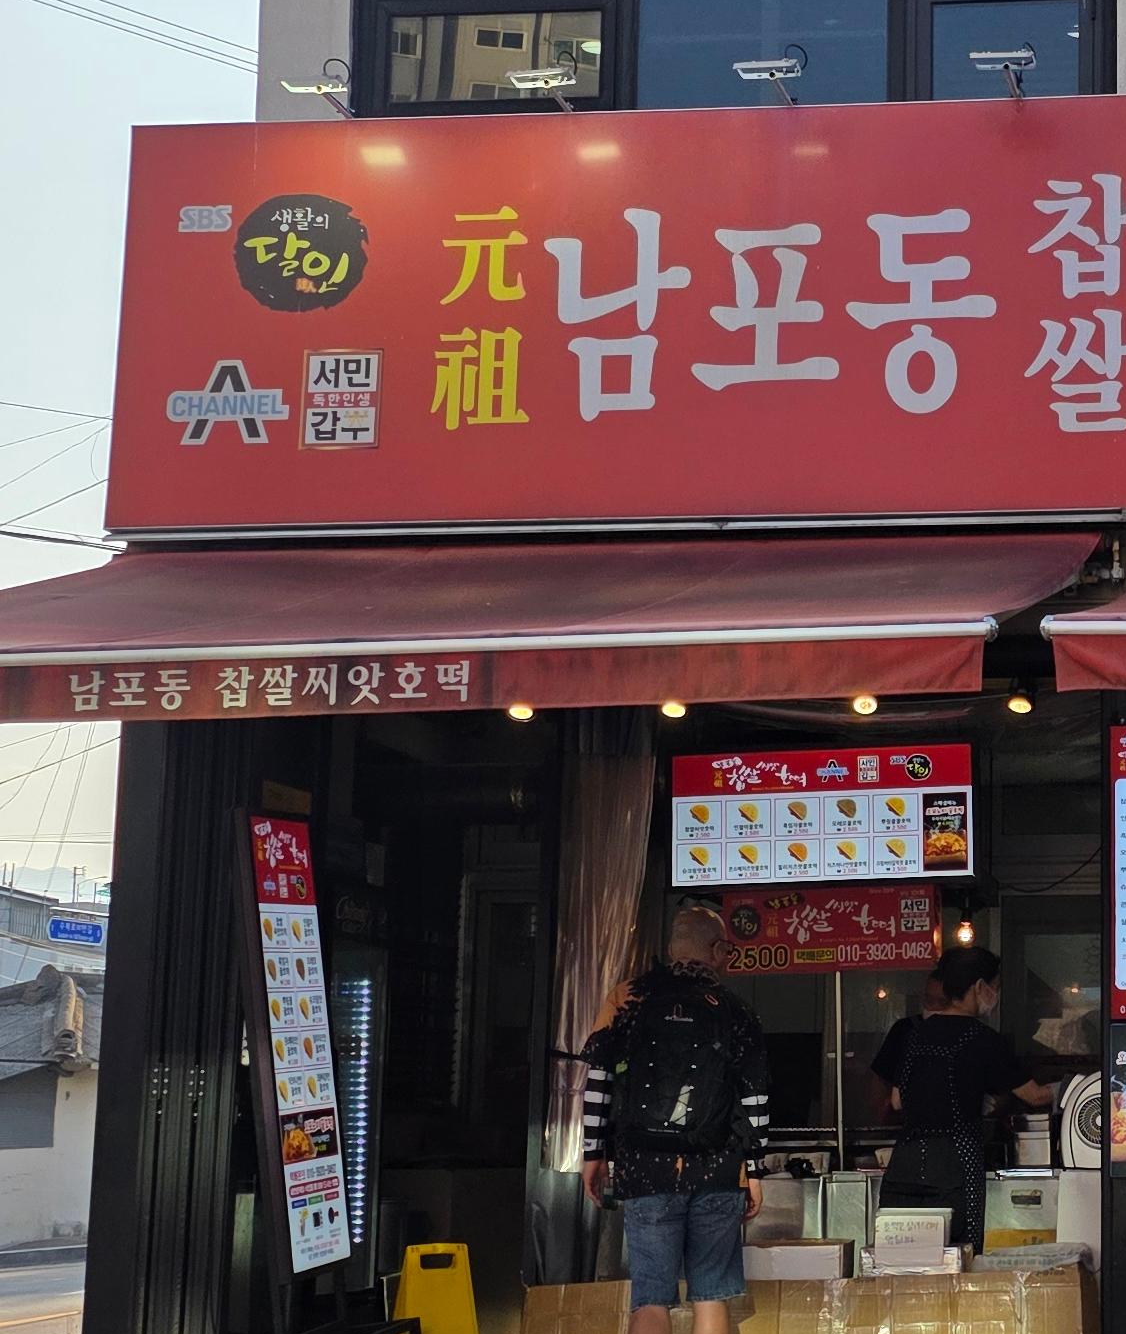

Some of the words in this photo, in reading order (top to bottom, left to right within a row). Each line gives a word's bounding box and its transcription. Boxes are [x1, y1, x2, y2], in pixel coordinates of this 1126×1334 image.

[179, 205, 233, 232] SBS
[270, 207, 330, 232] 생활의
[243, 231, 350, 294] 달인
[430, 205, 530, 431] 元祖
[543, 206, 998, 422] 남포동
[312, 357, 372, 389] 서민
[170, 394, 284, 417] CHANNEL
[312, 392, 371, 407] 독한인생
[69, 667, 192, 712] 남포동
[213, 659, 472, 710] 찹쌀씨앗호떡
[902, 898, 929, 913] 서민
[727, 944, 790, 971] 2500
[837, 941, 933, 962] 010-3920-0462
